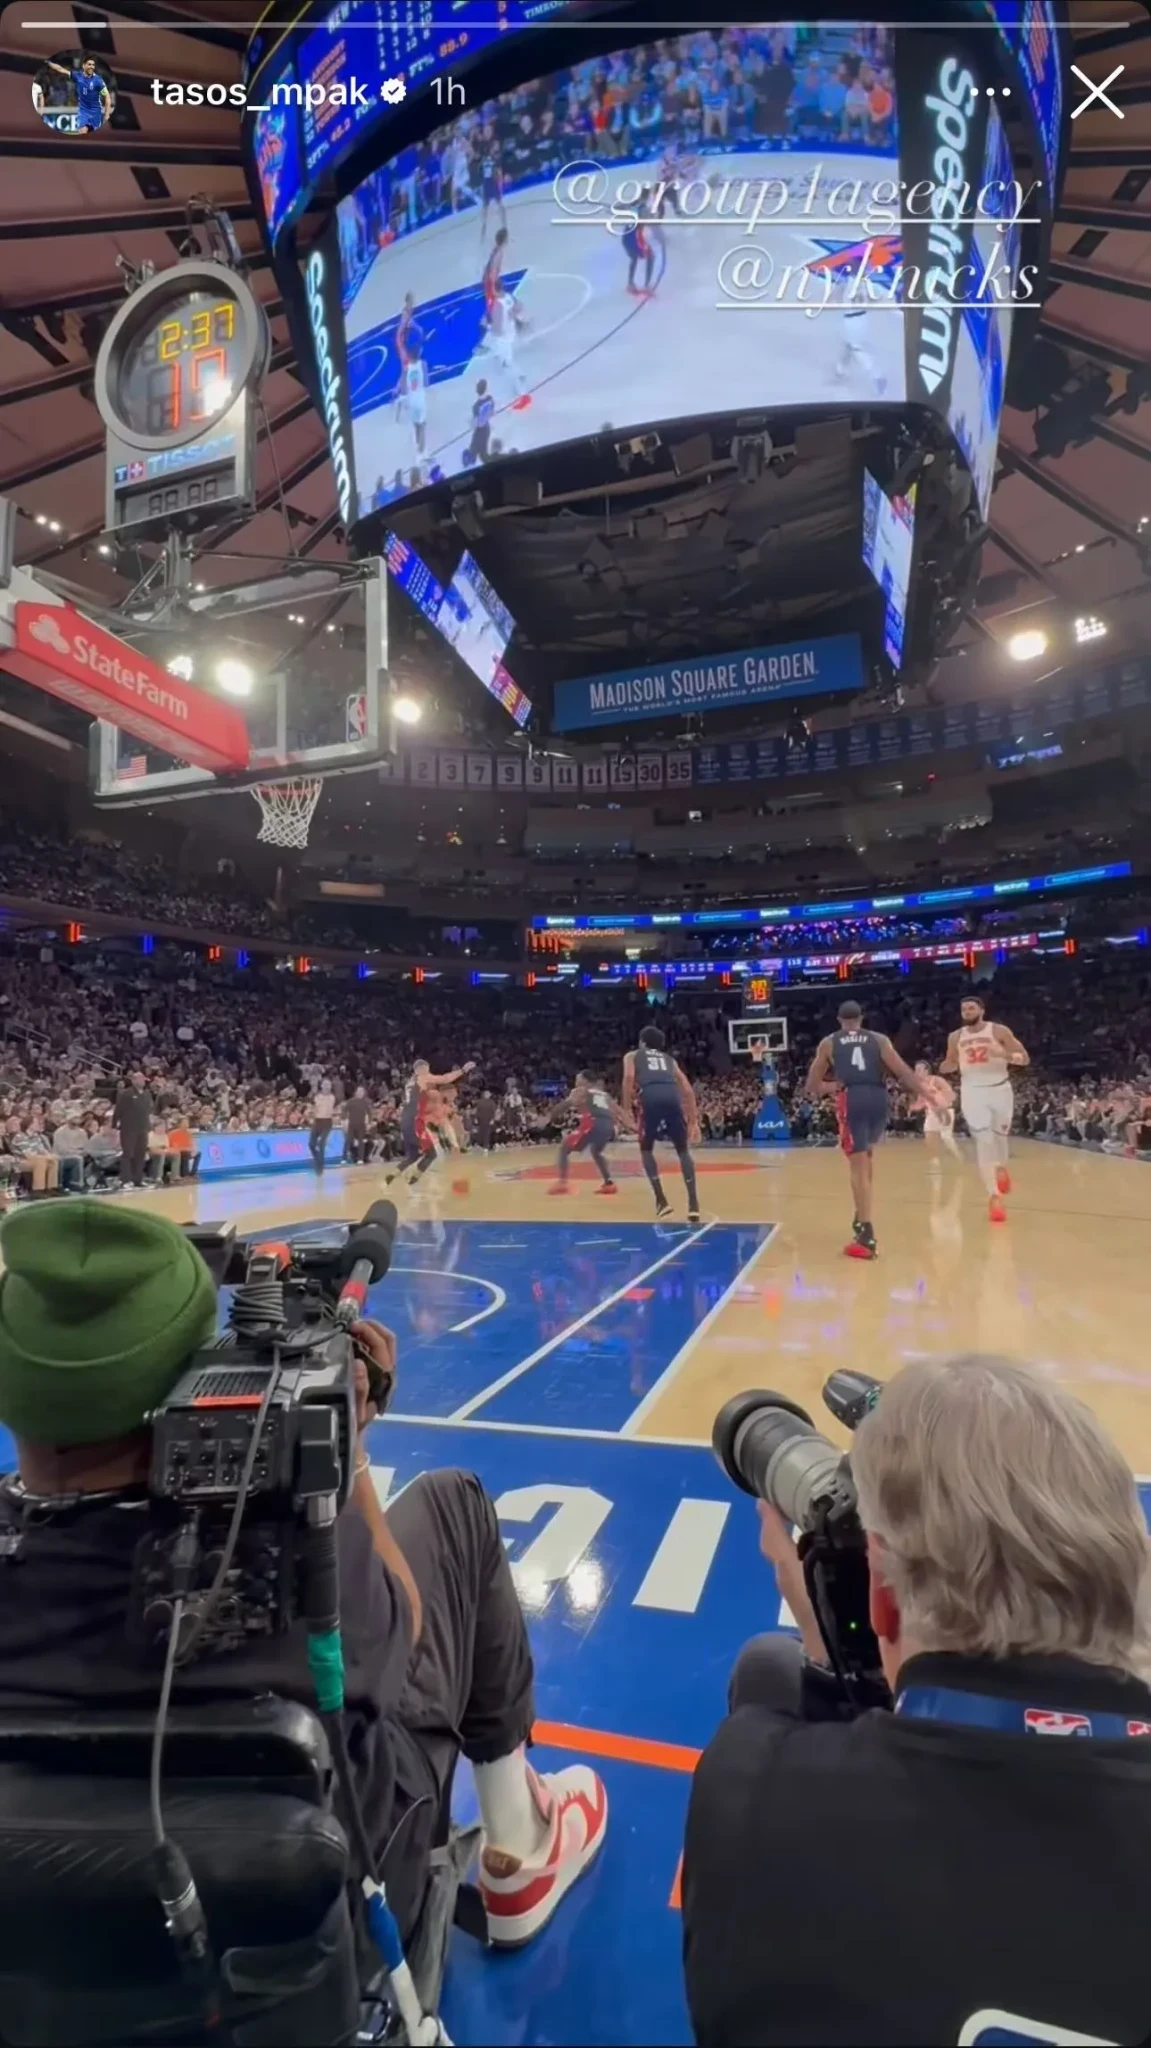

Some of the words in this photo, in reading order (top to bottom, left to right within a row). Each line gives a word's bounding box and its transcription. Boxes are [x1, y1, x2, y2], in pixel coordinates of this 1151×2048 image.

[159, 303, 234, 361] 2:37
[589, 675, 665, 709] MADISON
[671, 664, 738, 696] SQUARE
[743, 651, 815, 686] GARDEN
[474, 765, 485, 782] 7
[558, 767, 573, 784] 11
[587, 767, 602, 784] 11
[640, 763, 661, 782] 30
[669, 761, 691, 780] 35
[647, 1057, 667, 1071] 31
[851, 1046, 866, 1071] 4
[967, 1047, 988, 1064] 32
